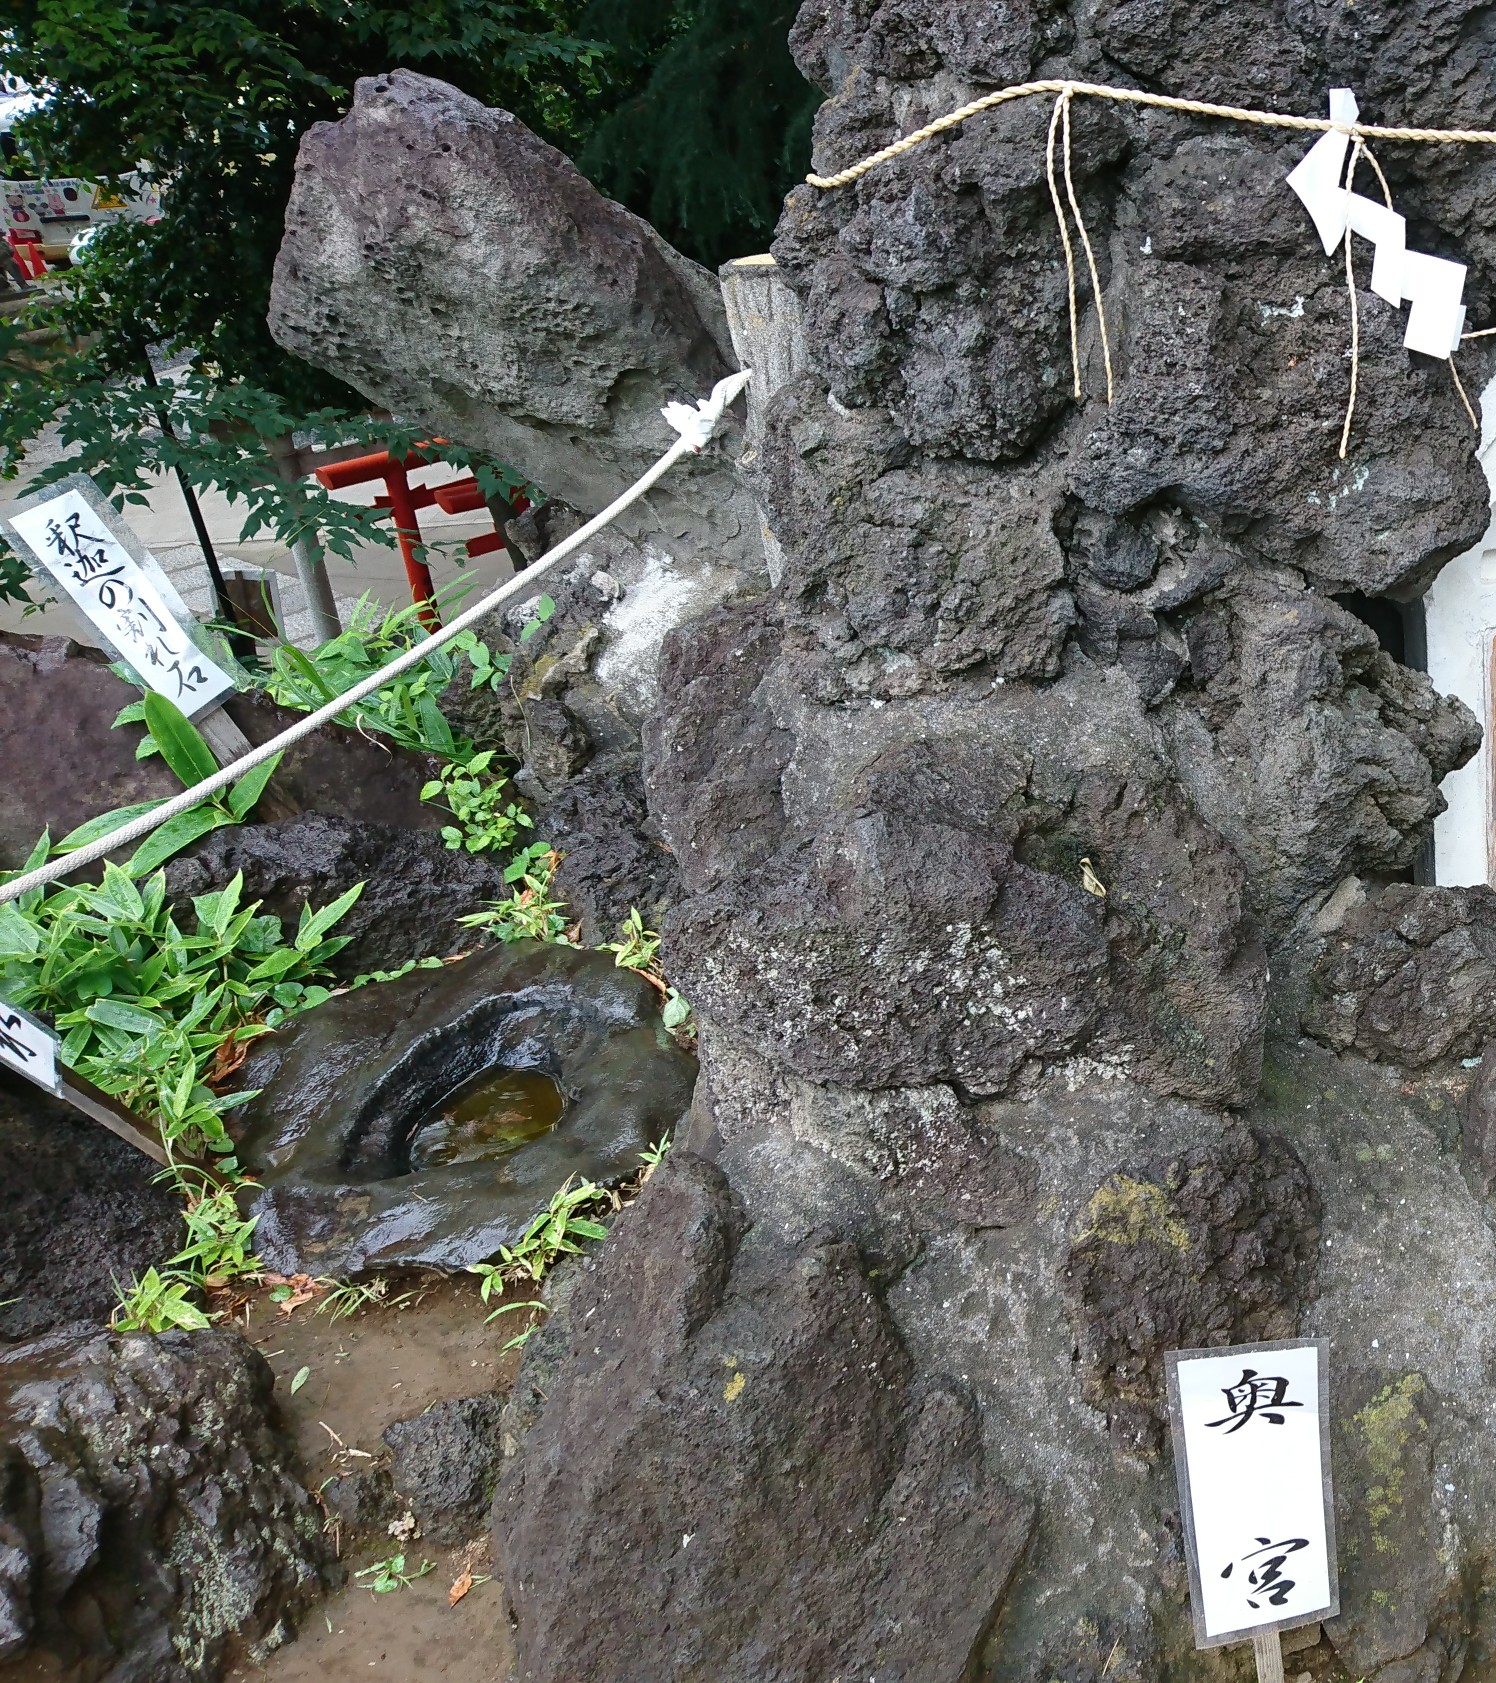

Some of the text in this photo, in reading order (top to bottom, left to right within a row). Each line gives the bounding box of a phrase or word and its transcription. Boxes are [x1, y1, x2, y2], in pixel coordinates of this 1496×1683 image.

[45, 511, 208, 698] 釈迦の割れ石
[1204, 1368, 1310, 1609] 奥宮
